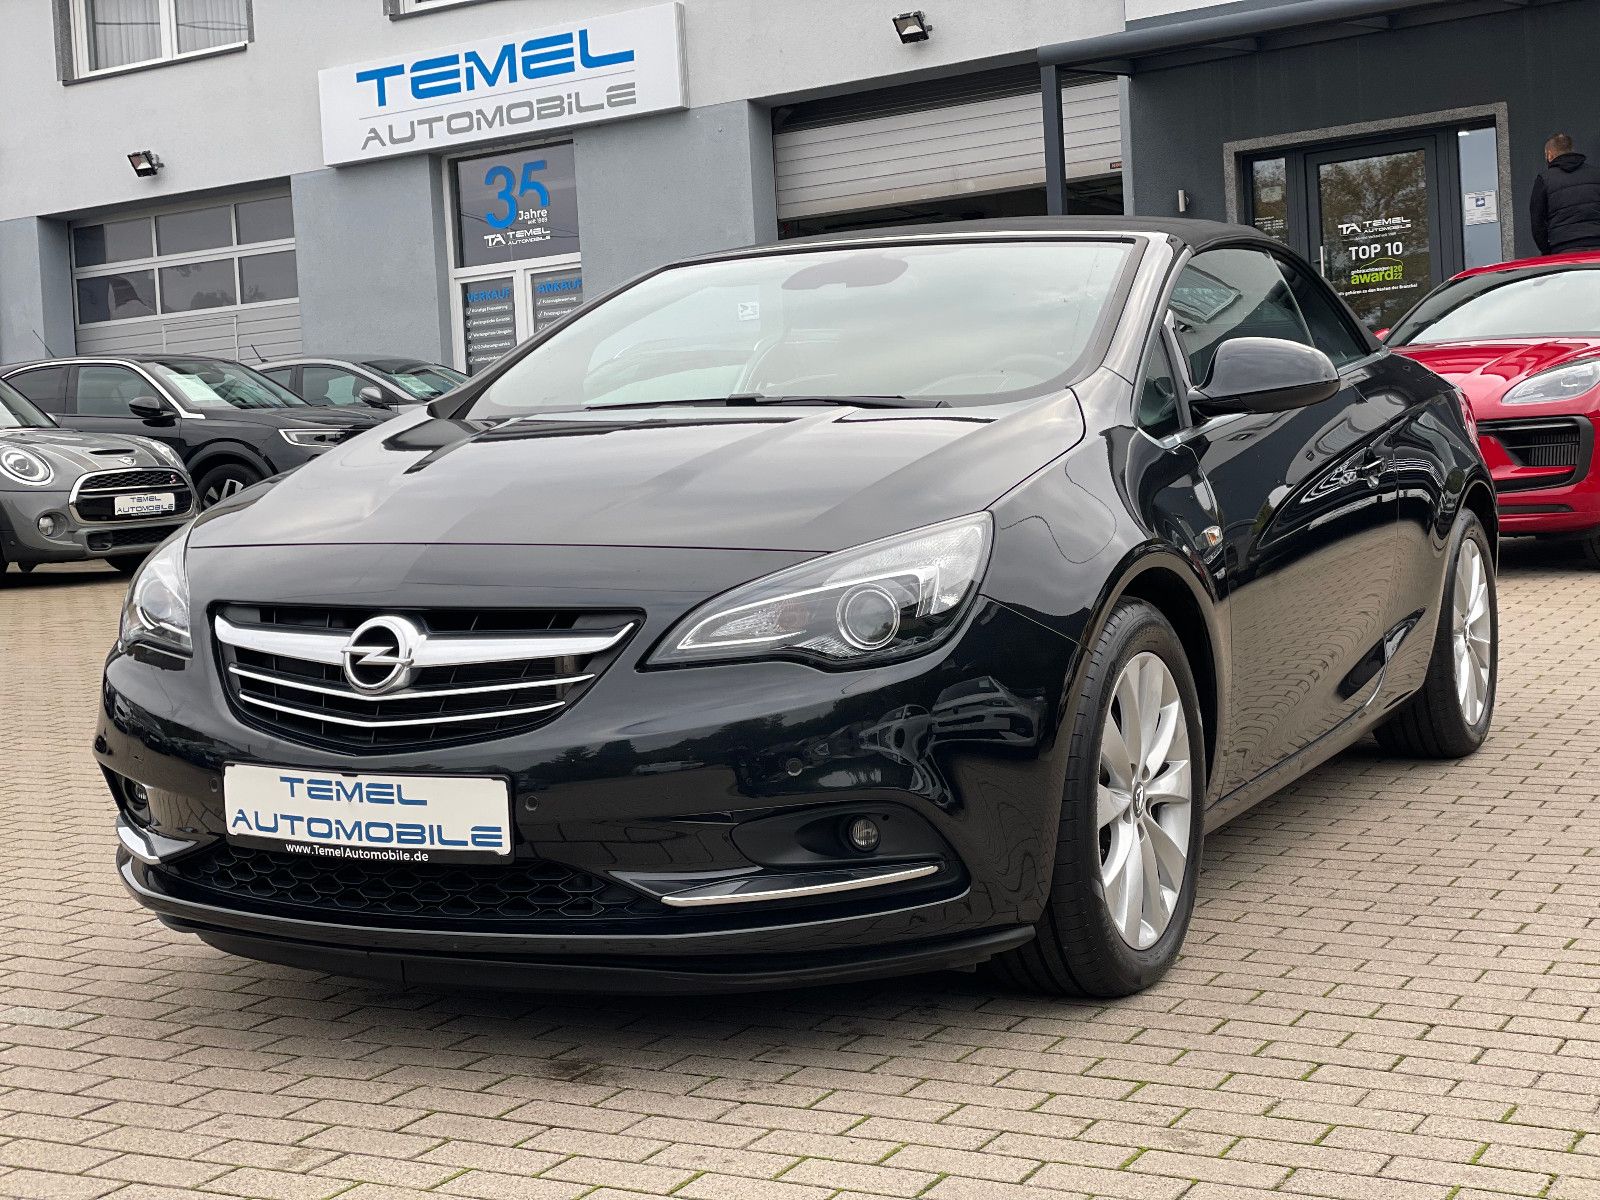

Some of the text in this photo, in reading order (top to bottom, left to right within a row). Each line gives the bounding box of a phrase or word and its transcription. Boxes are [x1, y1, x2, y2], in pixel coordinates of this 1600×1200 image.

[355, 29, 634, 106] TEMEL
[484, 160, 550, 229] 35
[518, 209, 548, 221] Jahre
[1363, 216, 1411, 228] TEMEL
[507, 227, 551, 239] TEMEL
[1349, 241, 1403, 260] TOP 10
[1350, 265, 1393, 285] award
[1394, 265, 1403, 273] 20
[1394, 272, 1403, 280] 22
[280, 776, 427, 806] TEMEL
[231, 809, 503, 848] AUTOMOBILE
[285, 843, 429, 862] www.TemelAutomobile.de
